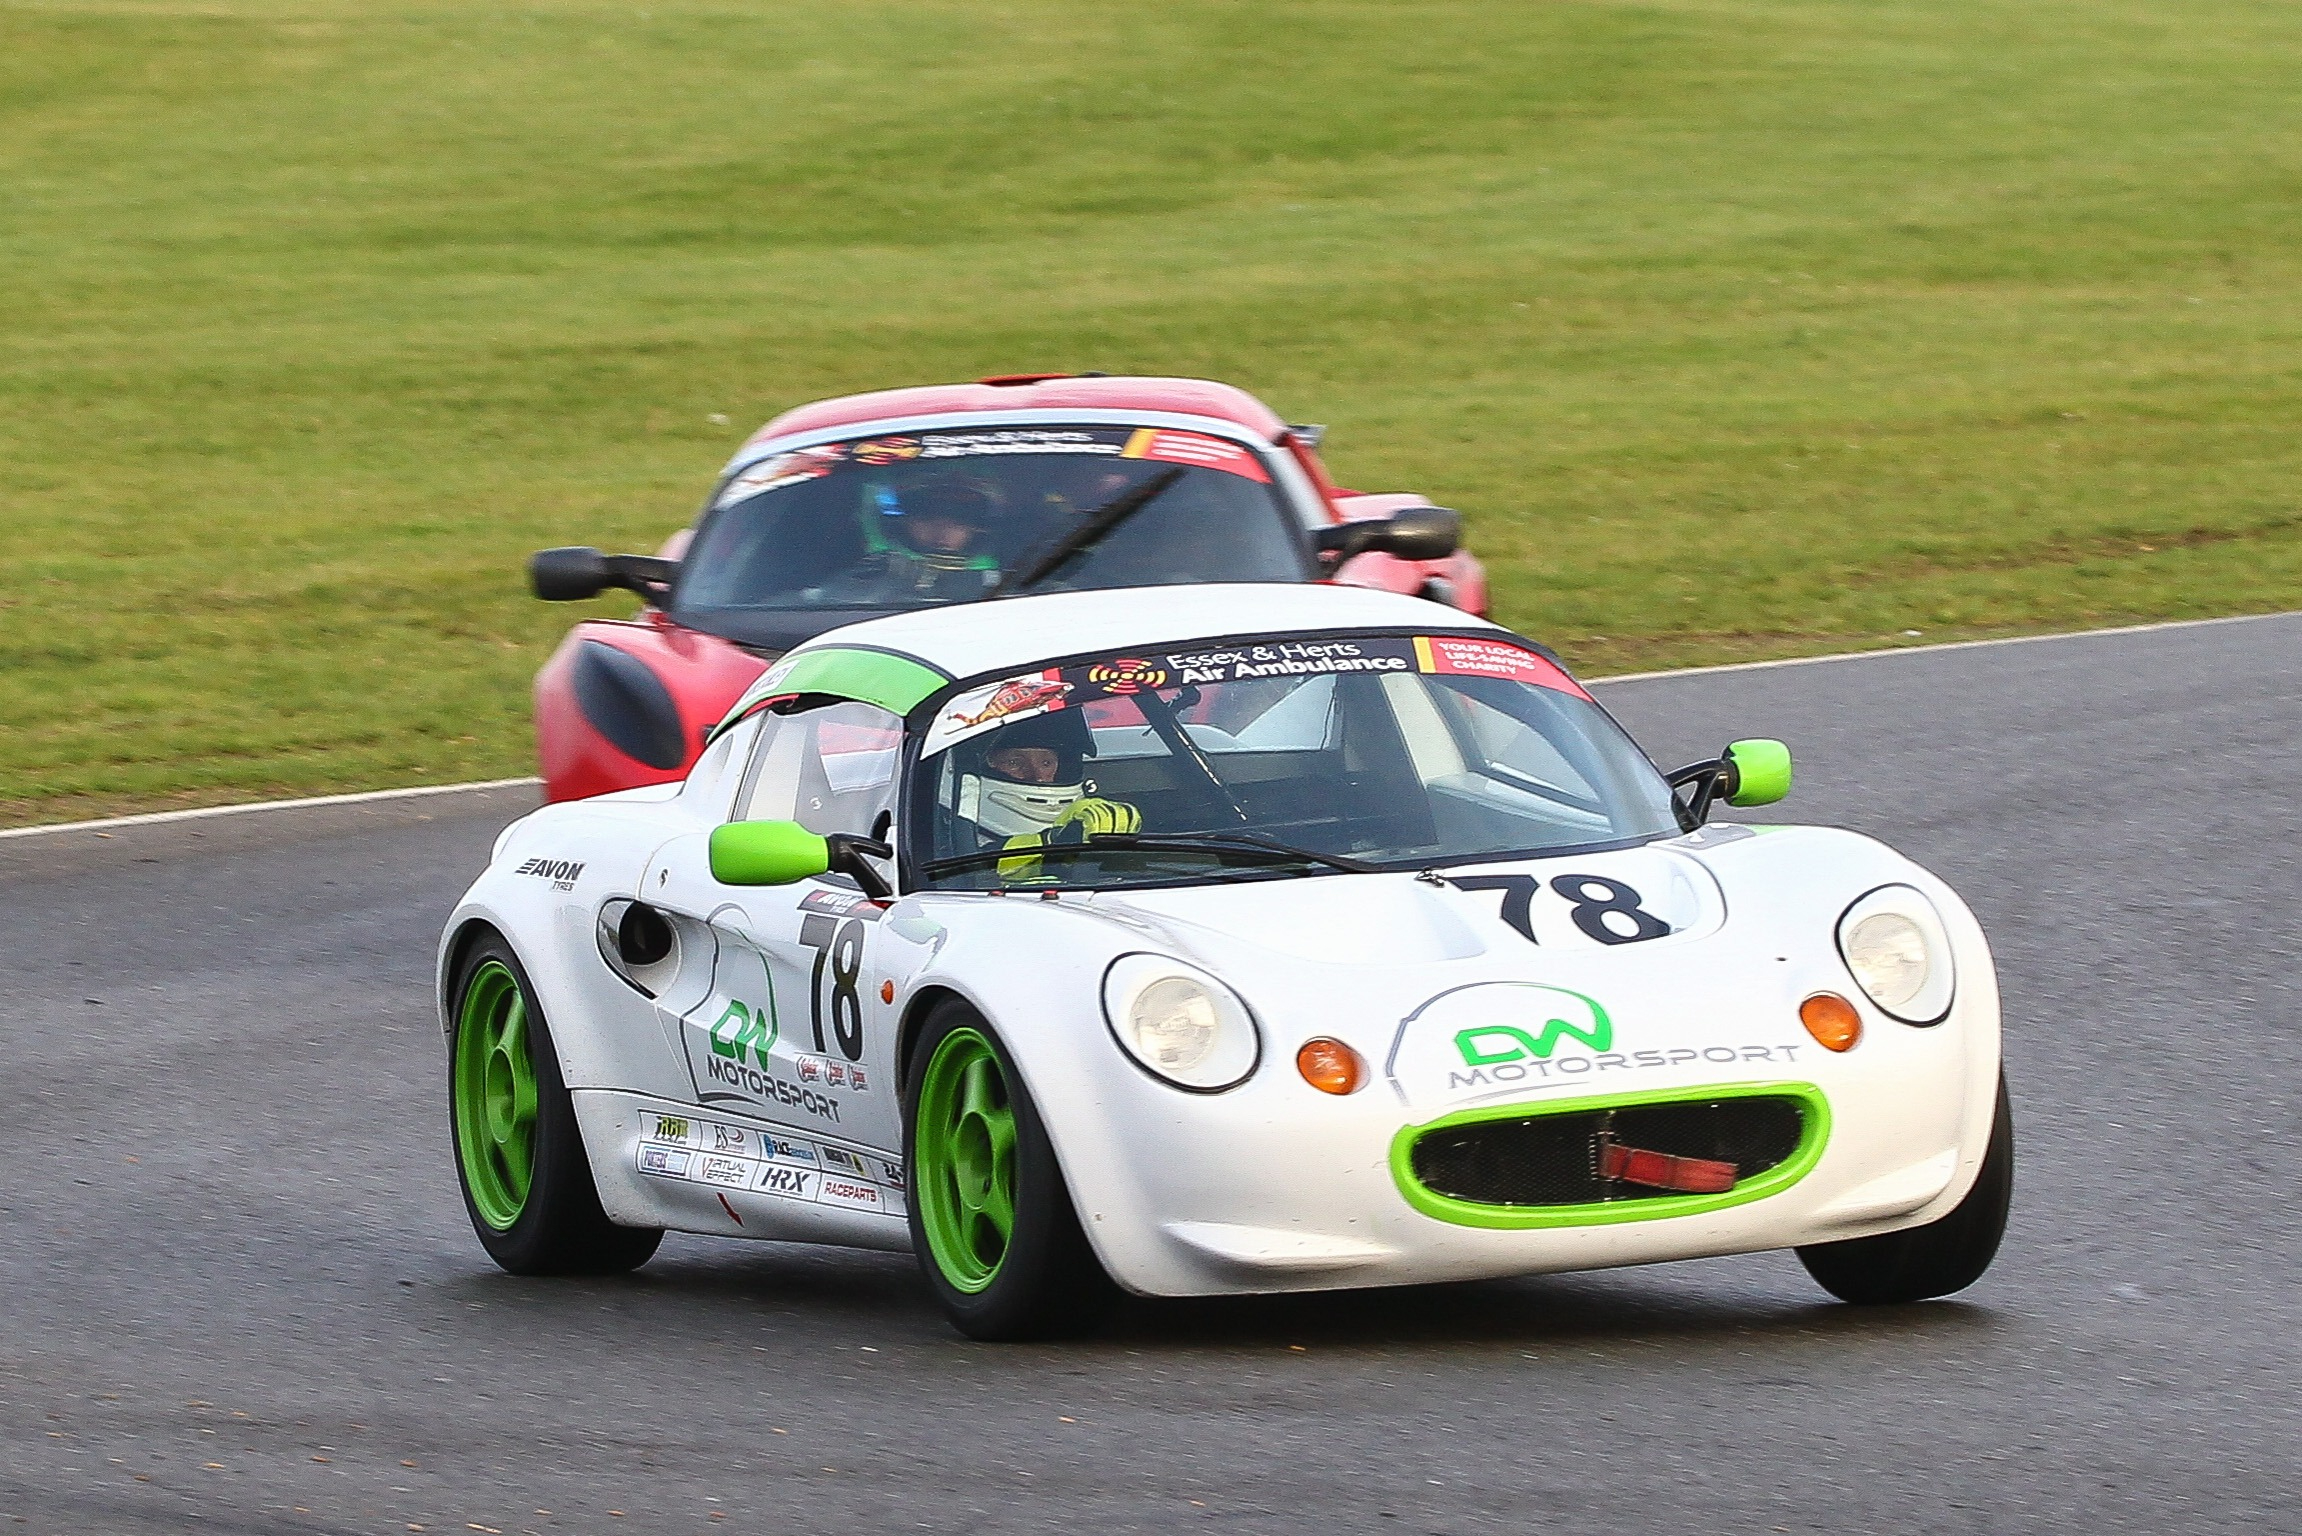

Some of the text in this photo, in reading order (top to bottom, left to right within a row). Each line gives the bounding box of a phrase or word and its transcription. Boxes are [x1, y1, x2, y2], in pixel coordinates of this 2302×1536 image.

[1166, 642, 1362, 670] Essex & Herts
[1438, 642, 1535, 662] YOUR LOCAL
[1181, 656, 1407, 685] Air Ambulance
[1452, 660, 1517, 675] CHARITY
[528, 859, 586, 881] AVON
[1446, 873, 1671, 946] 78
[799, 913, 865, 1062] 78
[710, 998, 779, 1073] DW
[1454, 1012, 1612, 1067] DW
[1448, 1045, 1802, 1090] MOTORSPORT
[707, 1054, 841, 1124] MOTORSPORT
[760, 1167, 811, 1193] HRX
[825, 1181, 877, 1203] RACEPARTS
